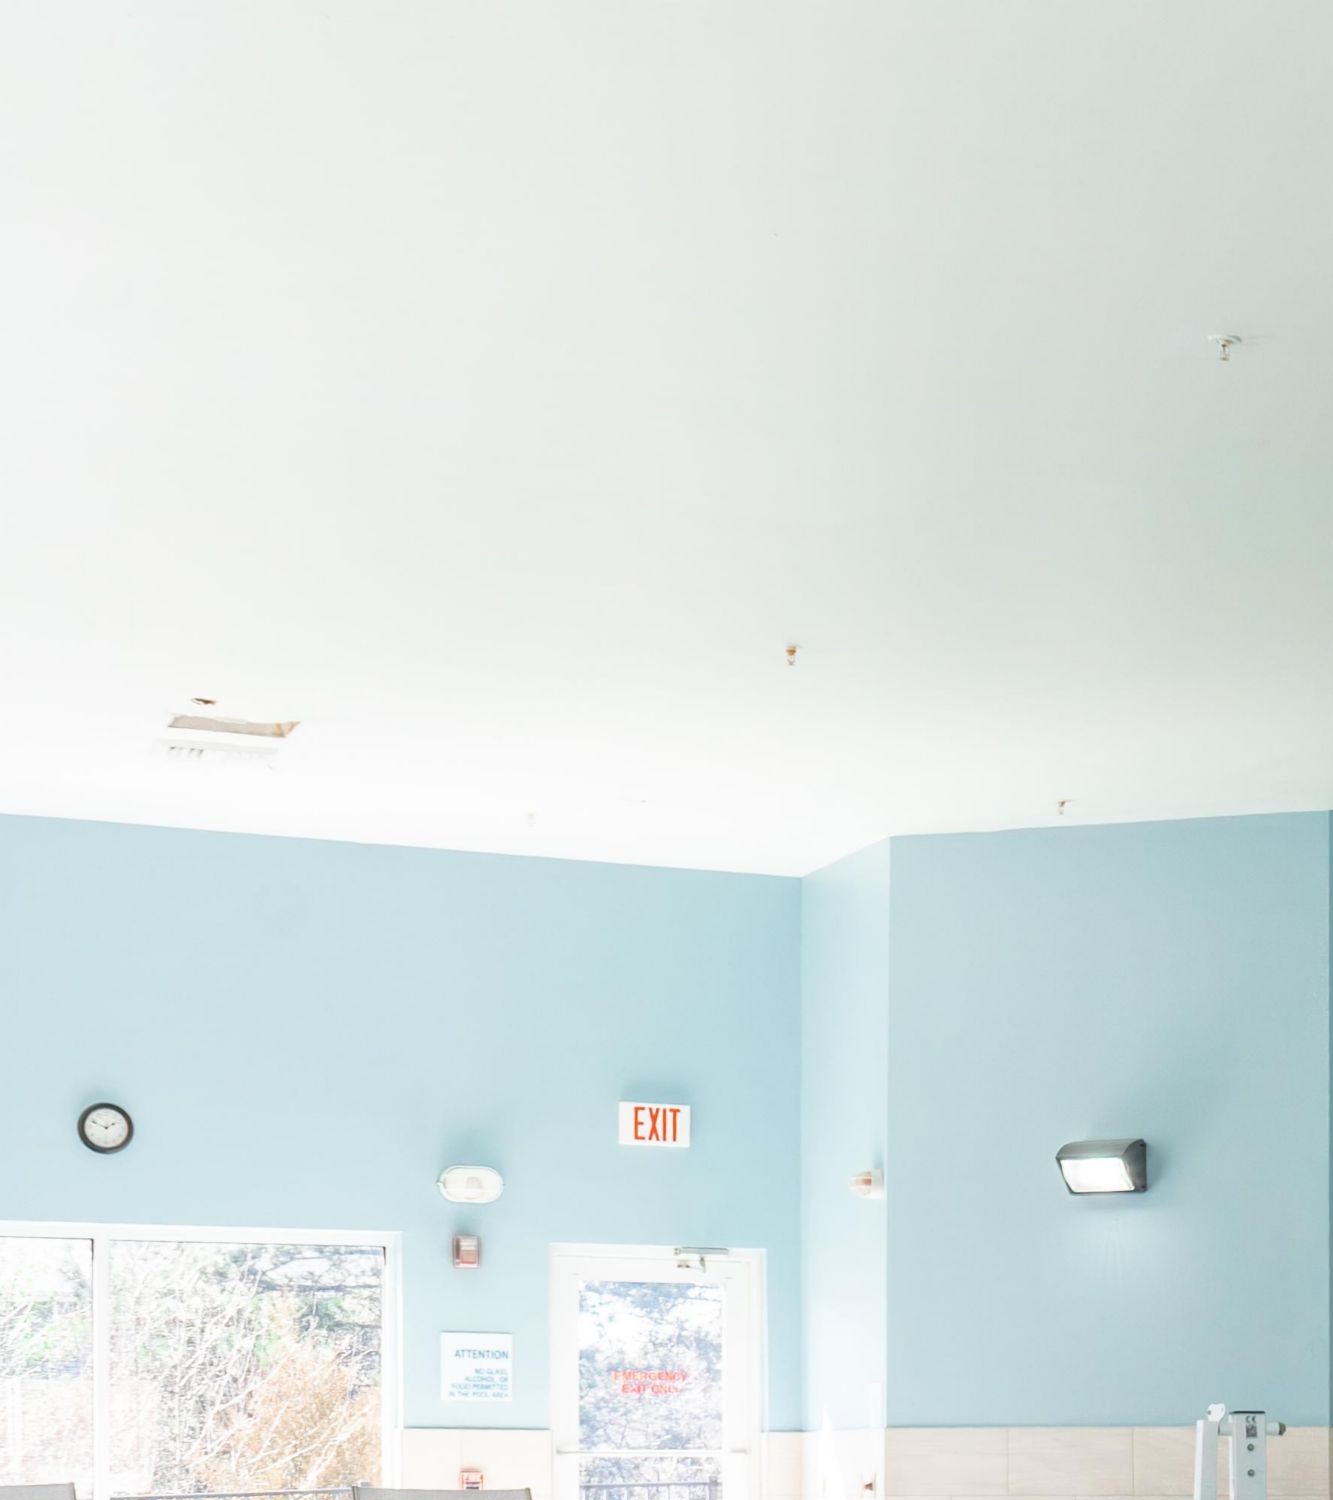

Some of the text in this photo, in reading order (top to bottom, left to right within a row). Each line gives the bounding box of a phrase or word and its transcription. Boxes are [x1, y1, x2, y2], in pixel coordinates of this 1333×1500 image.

[633, 1106, 681, 1142] EXIT
[454, 1349, 509, 1360] ATTENTION
[612, 1370, 688, 1382] EMERGENCY
[621, 1383, 647, 1394] EXIT
